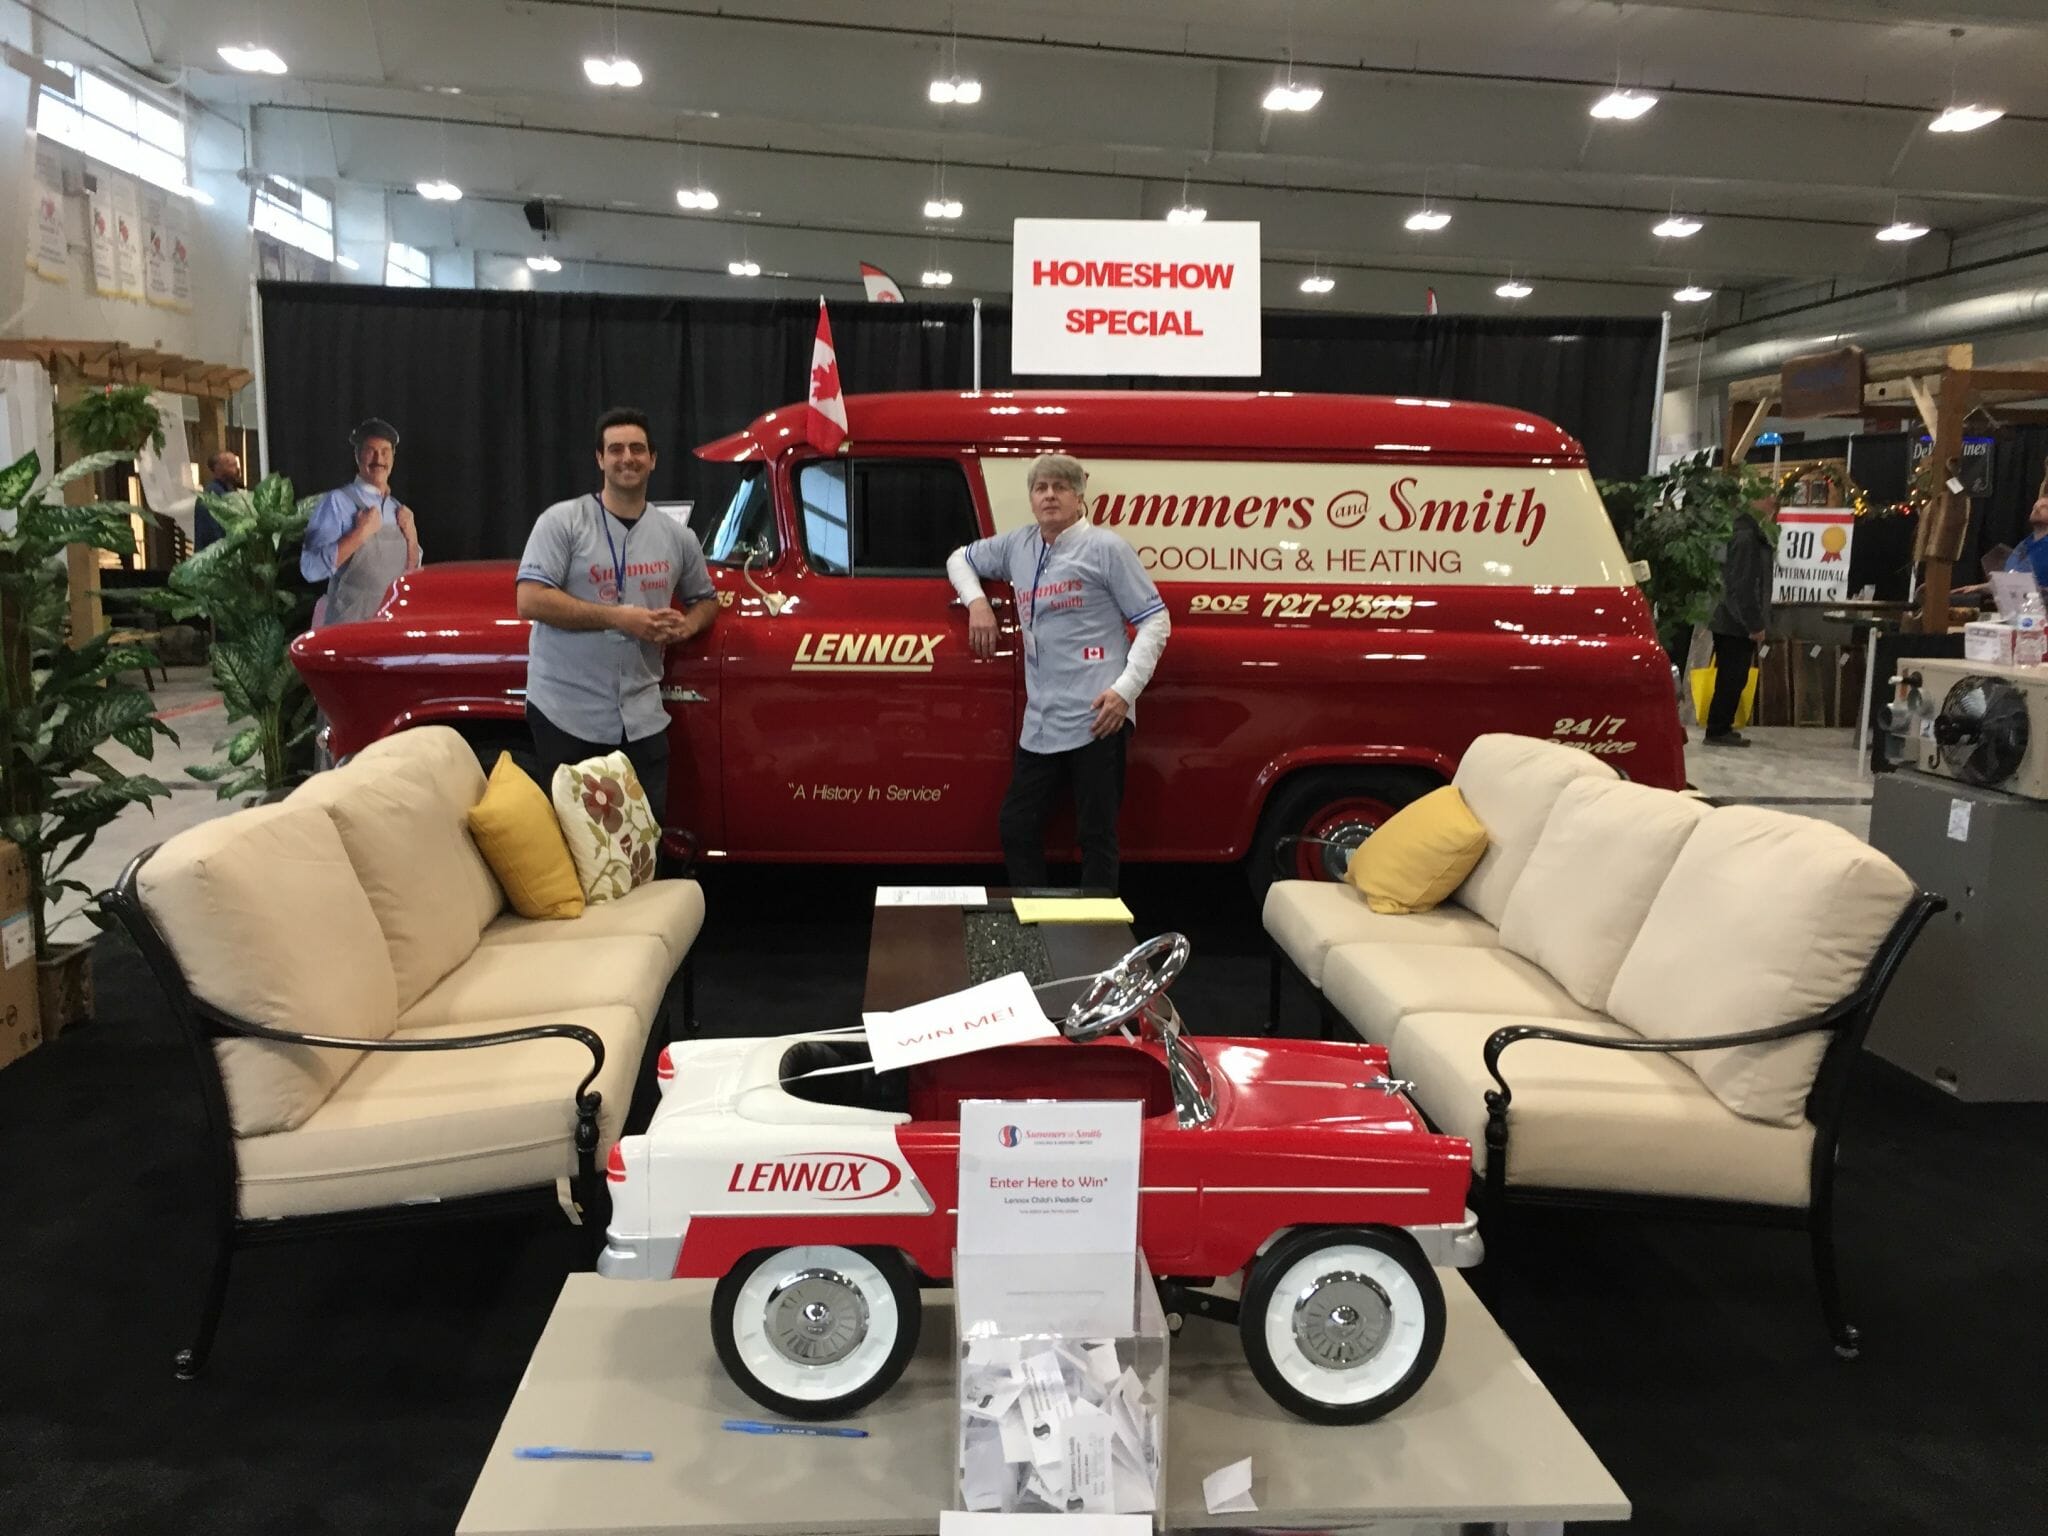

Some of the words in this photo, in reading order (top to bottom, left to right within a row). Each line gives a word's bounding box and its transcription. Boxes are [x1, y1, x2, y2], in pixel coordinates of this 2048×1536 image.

[1033, 260, 1234, 289] HOMESHOW
[1065, 308, 1204, 337] SPECIAL
[1086, 490, 1315, 530] ummers
[1379, 477, 1547, 547] Smith
[1786, 530, 1815, 560] 30
[588, 560, 670, 584] Sumers
[1137, 546, 1283, 571] COOLING
[1295, 548, 1315, 572] &
[1327, 548, 1462, 573] HEATING
[1773, 565, 1847, 582] INTERNATIONAL
[1190, 594, 1249, 613] 905
[794, 633, 946, 663] LENNOX
[1553, 715, 1627, 738] 24/7
[812, 783, 863, 803] History
[868, 784, 881, 800] In
[897, 1026, 954, 1047] WIN
[964, 1006, 1015, 1032] ME!
[728, 1162, 868, 1192] LENNOX
[990, 1177, 1024, 1188] Enter
[1027, 1176, 1058, 1188] Here
[1062, 1176, 1075, 1188] to
